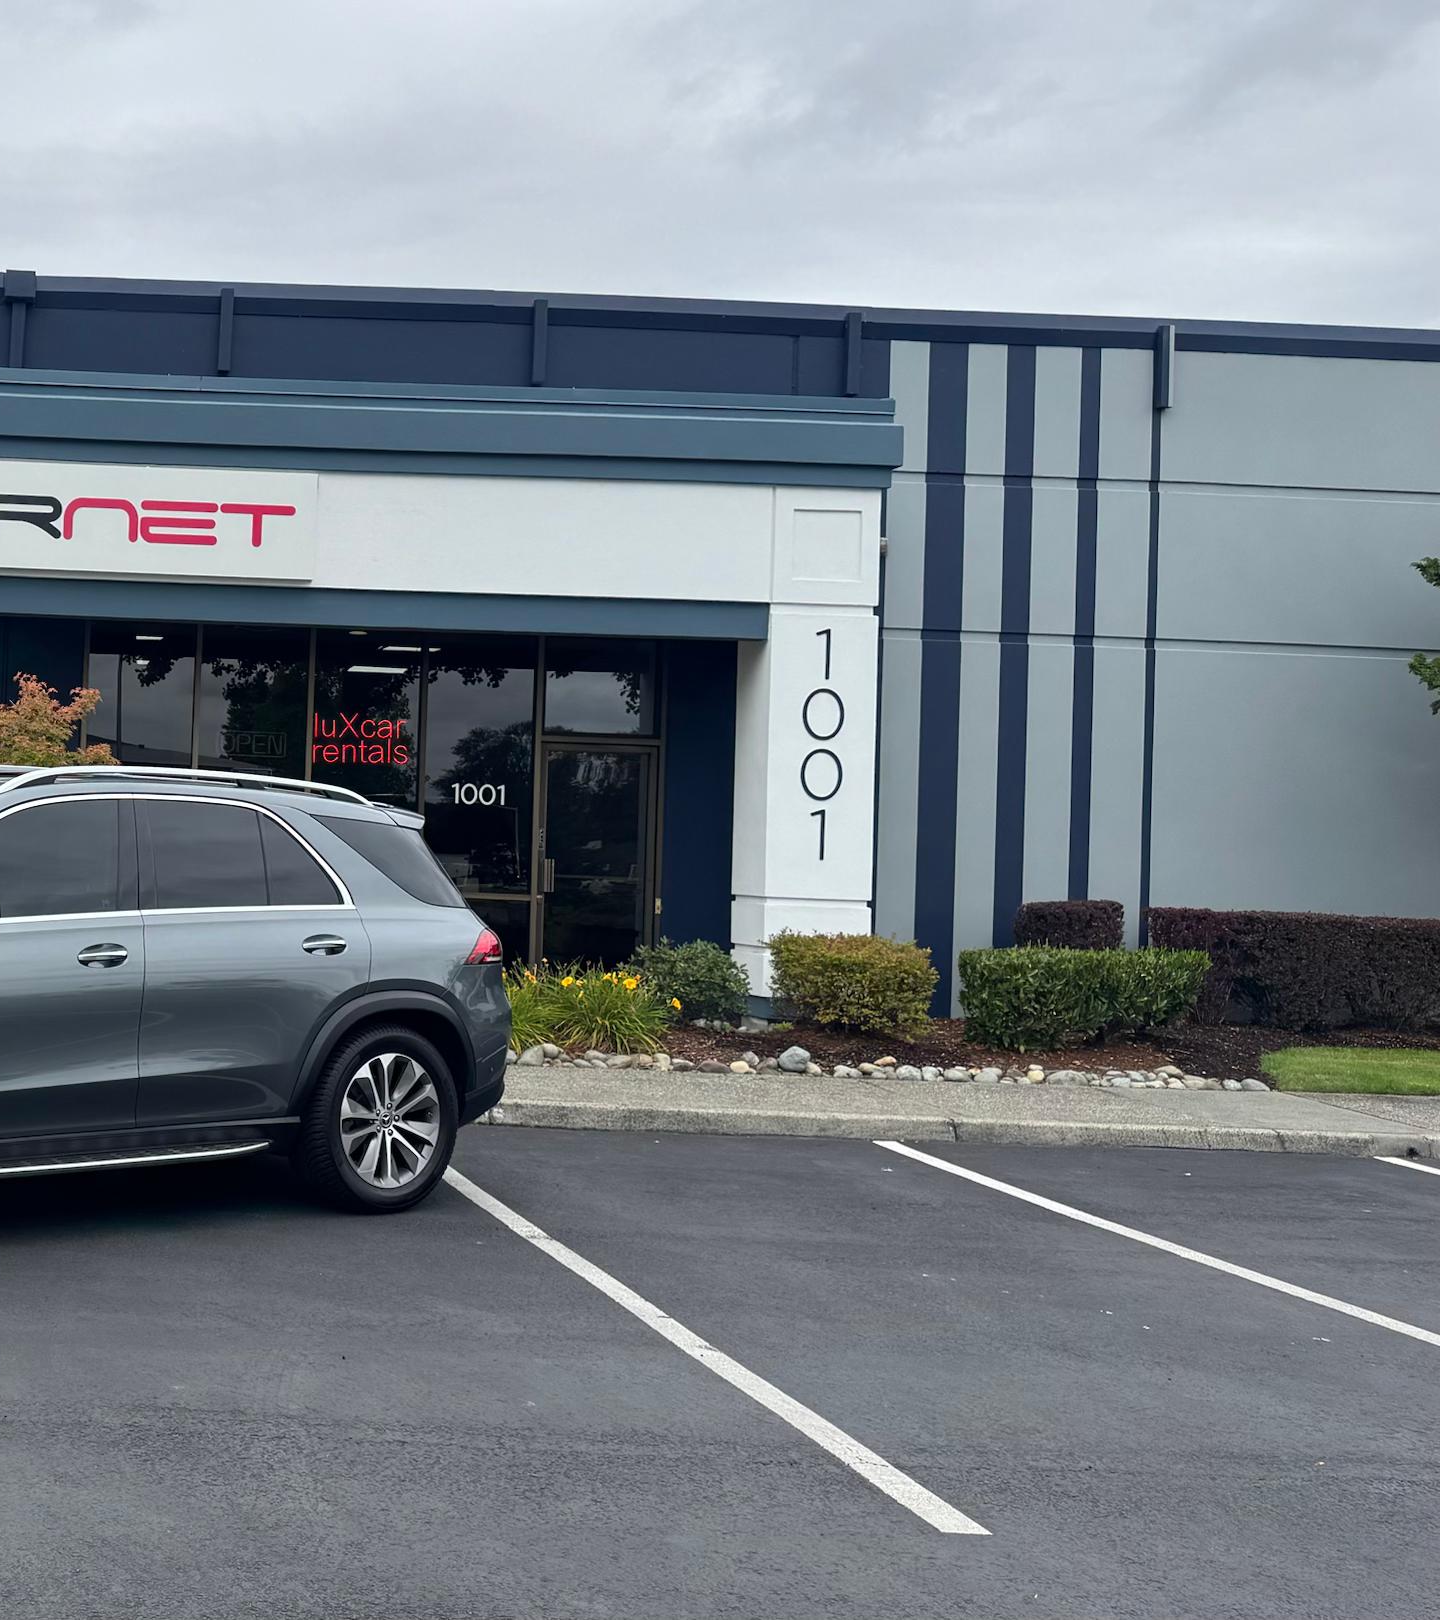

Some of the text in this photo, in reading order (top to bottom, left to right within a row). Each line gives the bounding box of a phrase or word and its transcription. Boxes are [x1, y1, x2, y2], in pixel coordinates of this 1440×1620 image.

[313, 712, 408, 739] luXcar
[223, 734, 283, 755] OPEN
[311, 739, 409, 765] rentals
[800, 628, 845, 861] 1001
[451, 782, 506, 806] 1001
